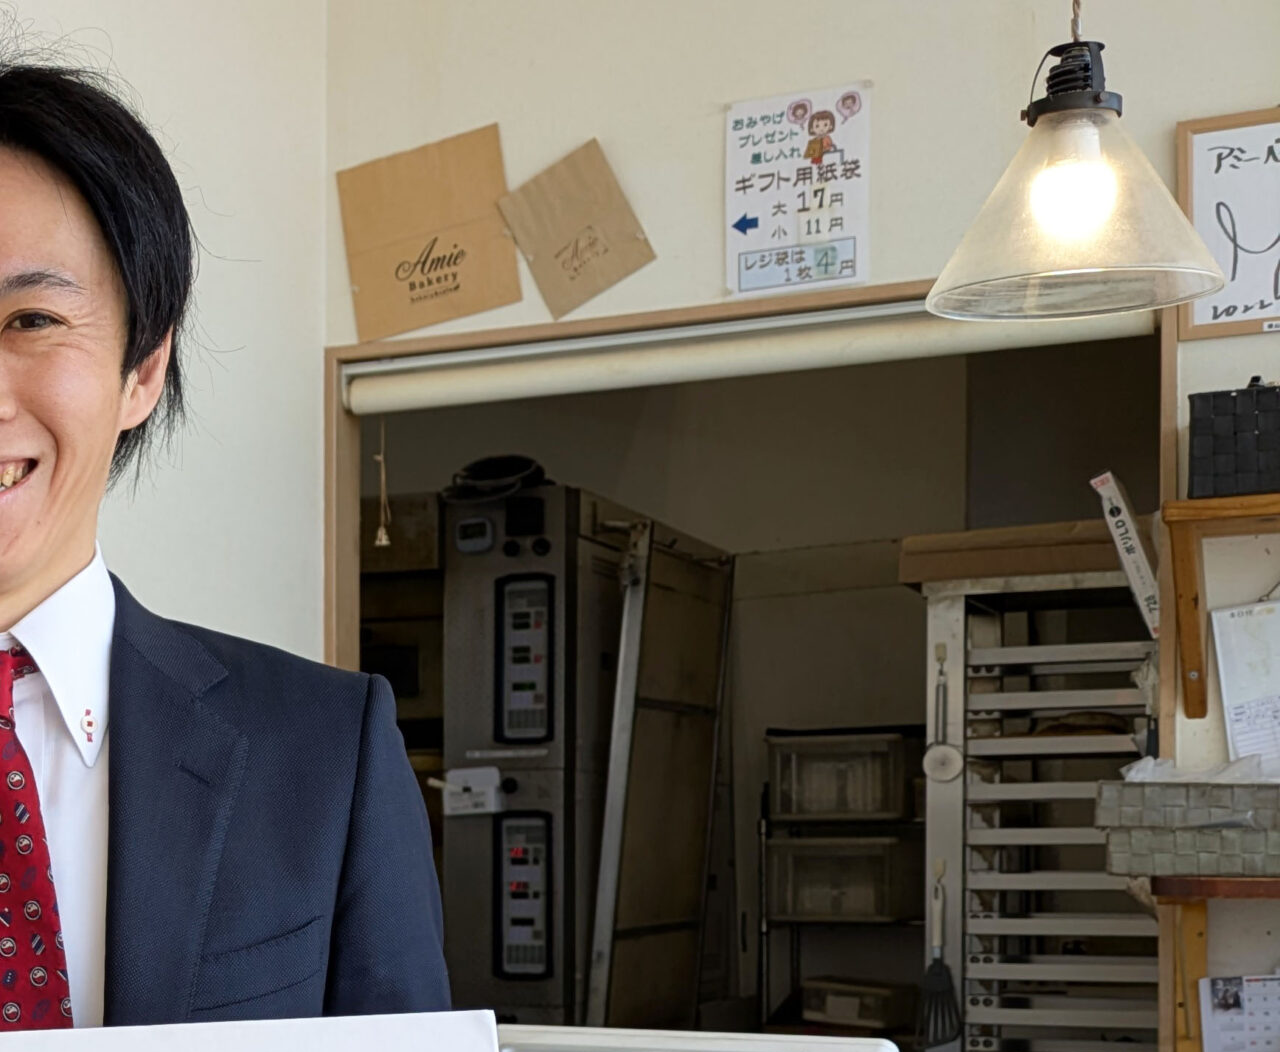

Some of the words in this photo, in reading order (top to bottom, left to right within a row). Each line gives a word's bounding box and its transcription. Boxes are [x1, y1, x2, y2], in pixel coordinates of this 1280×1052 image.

[732, 111, 785, 131] おみやげ
[738, 128, 799, 148] プレゼント
[734, 159, 862, 194] ギフト用紙袋
[772, 201, 787, 216] 大
[772, 225, 788, 240] 小
[395, 236, 466, 281] Amie
[745, 249, 806, 270] レジ袋は
[408, 272, 458, 292] Bakery
